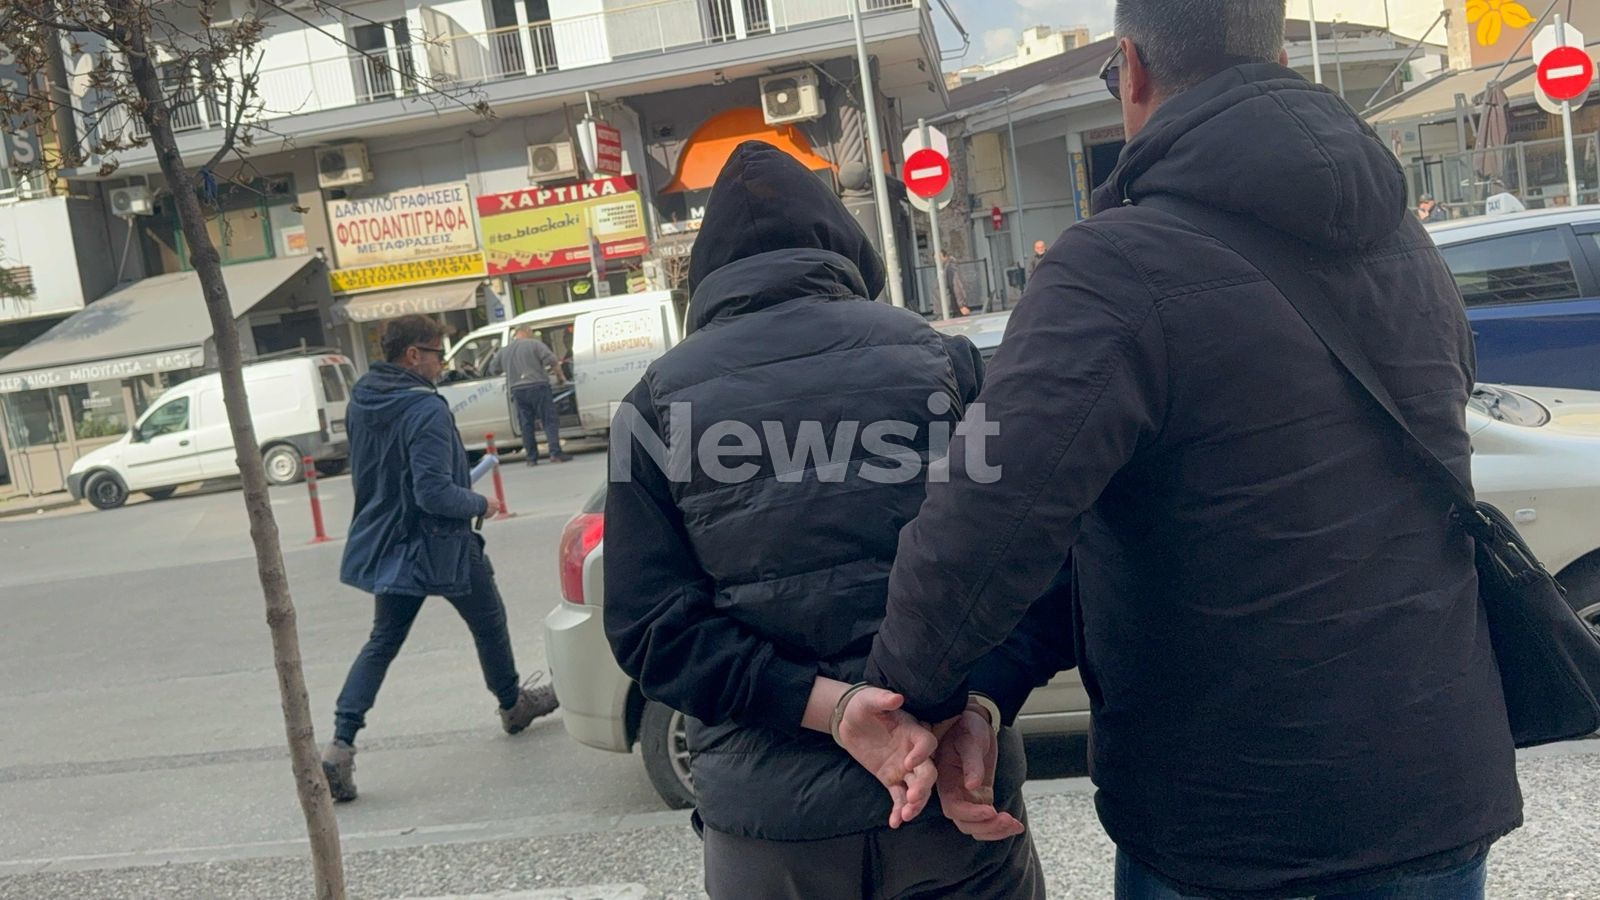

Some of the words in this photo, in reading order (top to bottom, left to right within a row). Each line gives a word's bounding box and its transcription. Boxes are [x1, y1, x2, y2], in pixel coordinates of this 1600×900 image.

[335, 188, 463, 218] ΔΑΚΤΥΛΟΓΡΑΦΗΣΕΙΣ
[499, 181, 617, 210] ΧΑΡΤΙΚΑ
[336, 206, 469, 246] ΦΩΤΟΑΝΤΙΓΡΑΦΑ
[357, 233, 453, 254] ΜΕΤΑΦΡΑΣΕΙΣ
[332, 253, 483, 279] ΔΑΚΤΥΛΟΓΡΑΦΗΣΕΙΣ
[345, 263, 472, 286] ΦΩΤΟΑΝΤΙΓΡΑΦΑ
[70, 361, 142, 380] ΜΠΟΥΓΑΤΣΑ
